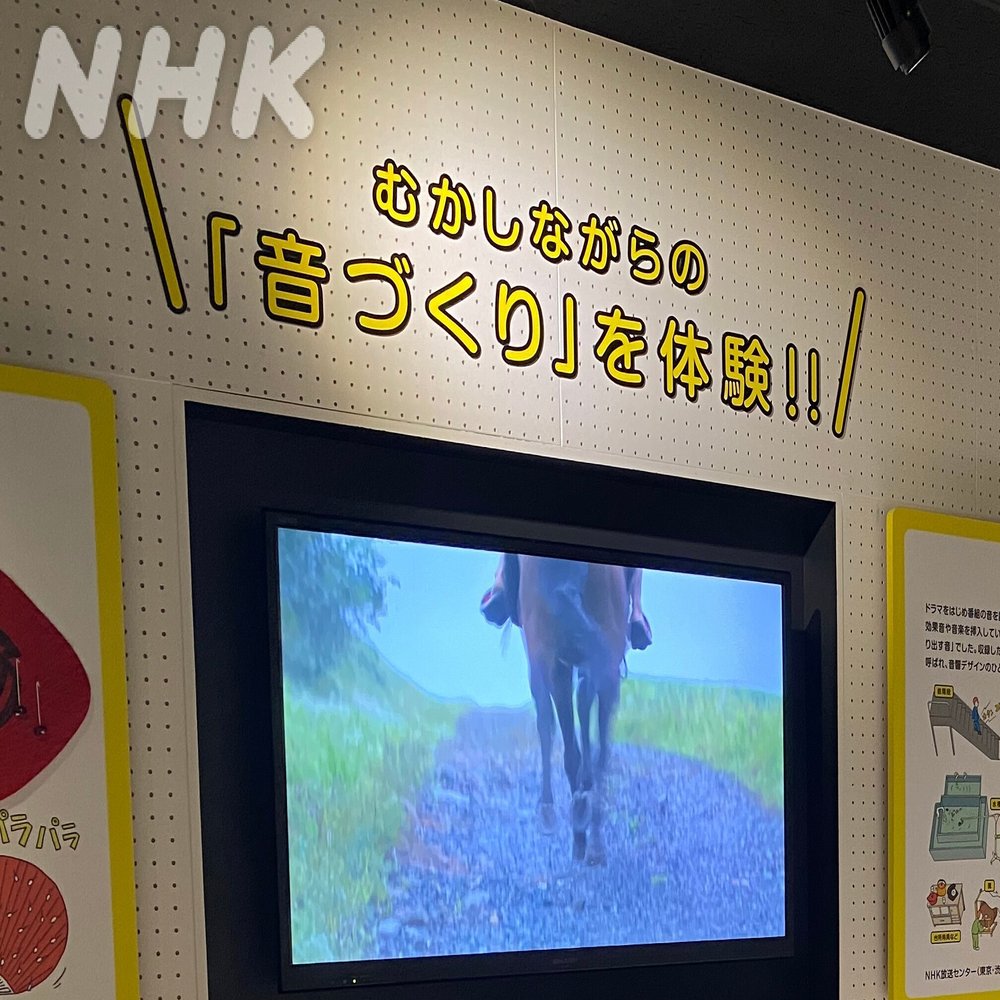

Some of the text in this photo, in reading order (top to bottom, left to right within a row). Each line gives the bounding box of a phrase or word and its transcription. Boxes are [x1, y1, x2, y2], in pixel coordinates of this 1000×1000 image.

[373, 159, 708, 295] むかしながらの
